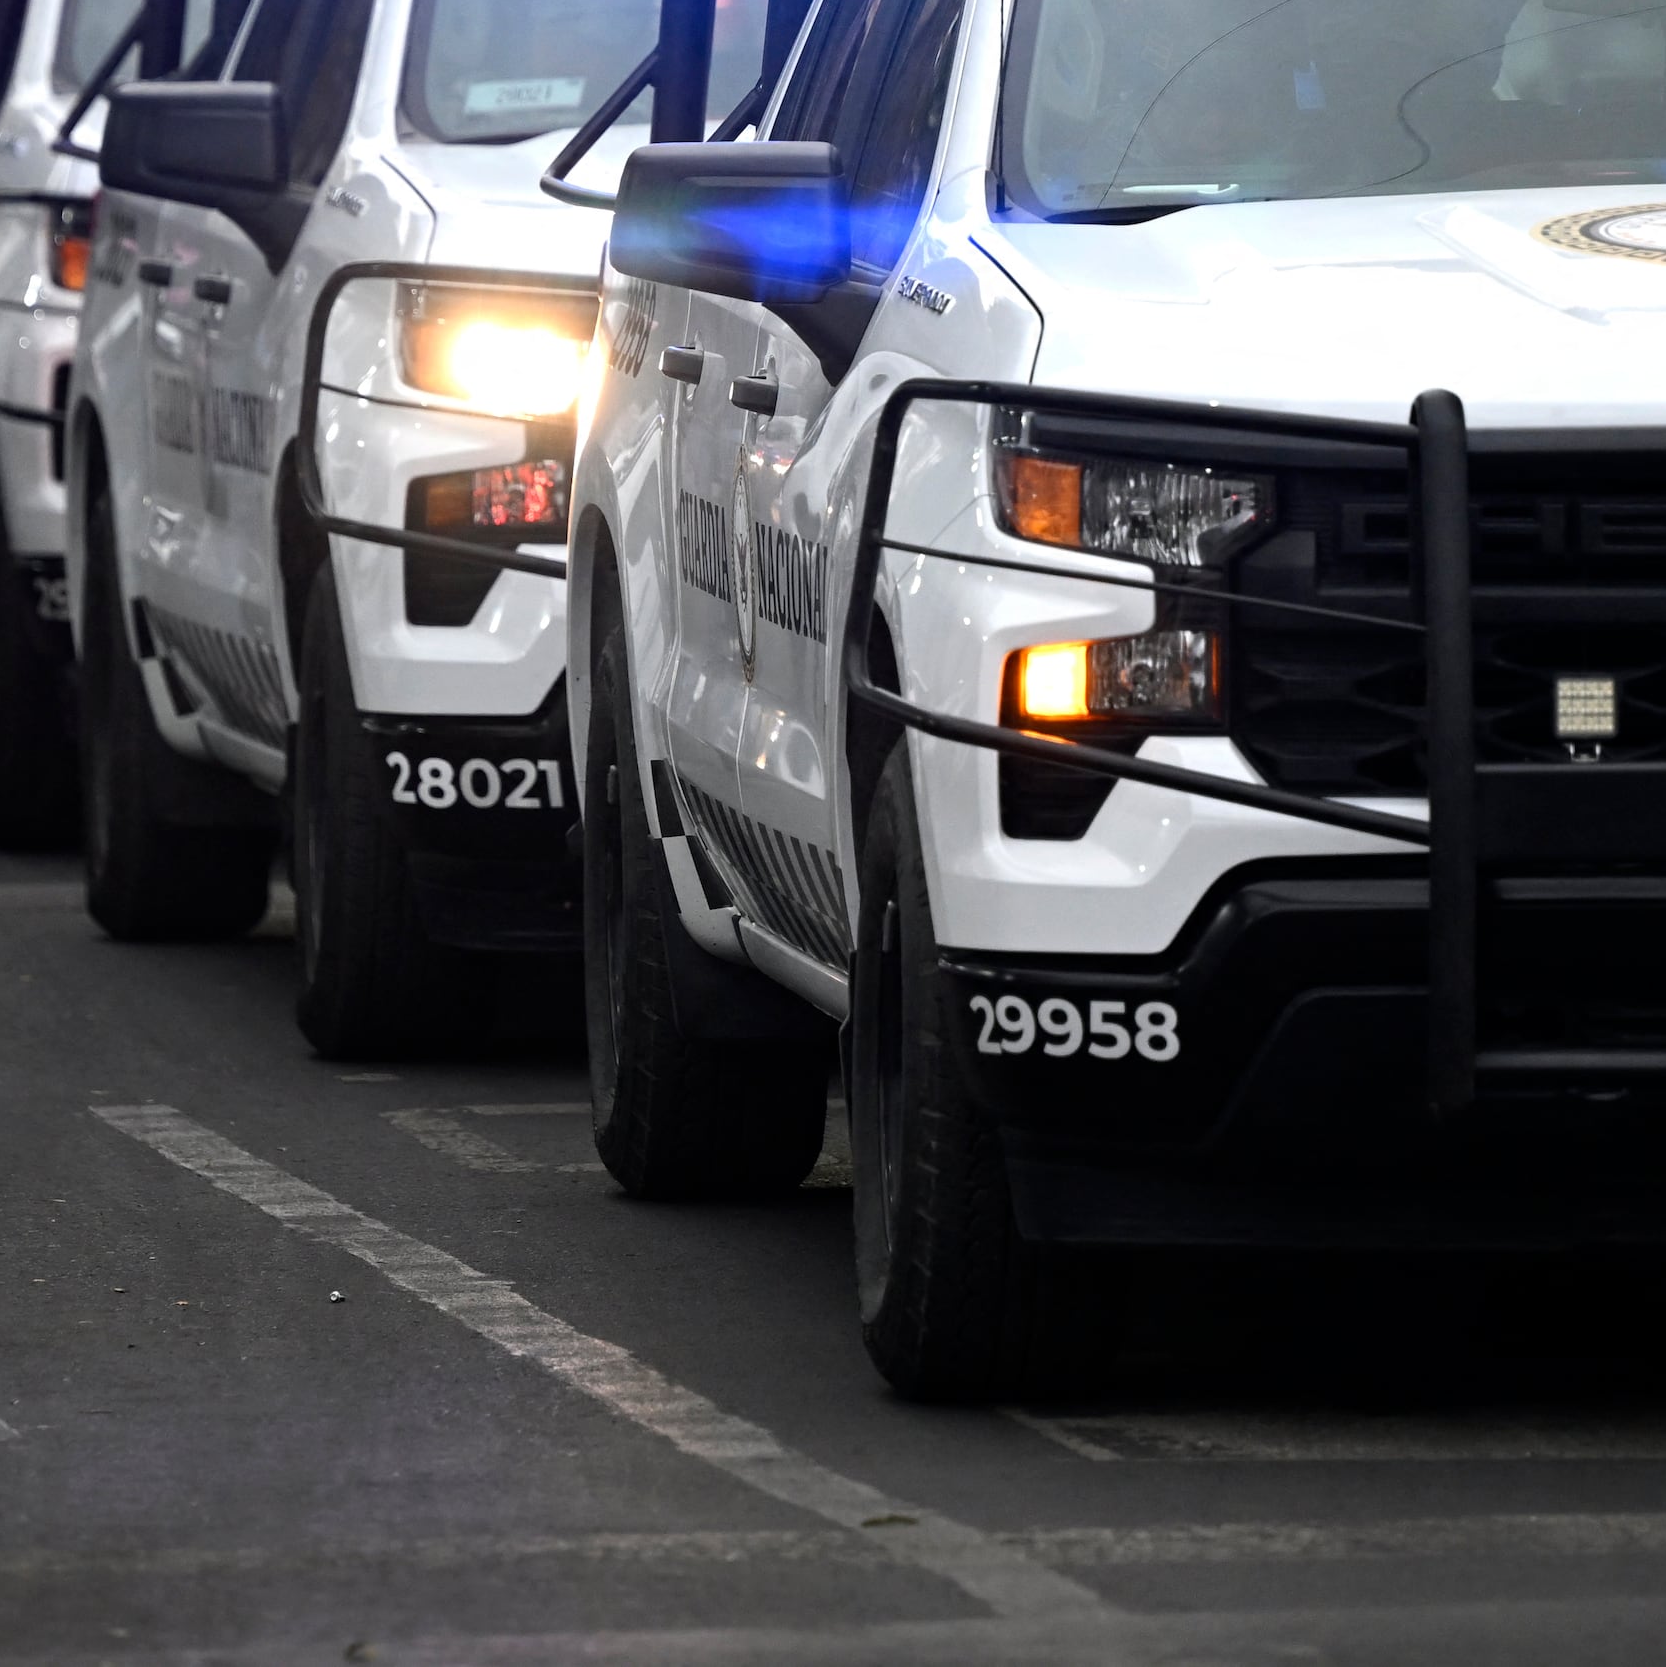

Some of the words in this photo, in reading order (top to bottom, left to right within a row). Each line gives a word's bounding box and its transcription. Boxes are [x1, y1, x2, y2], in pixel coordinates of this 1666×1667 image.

[679, 488, 732, 604] GUARDIA
[755, 521, 828, 646] NACIONAL
[385, 750, 564, 809] 28021
[969, 995, 1181, 1062] 29958
